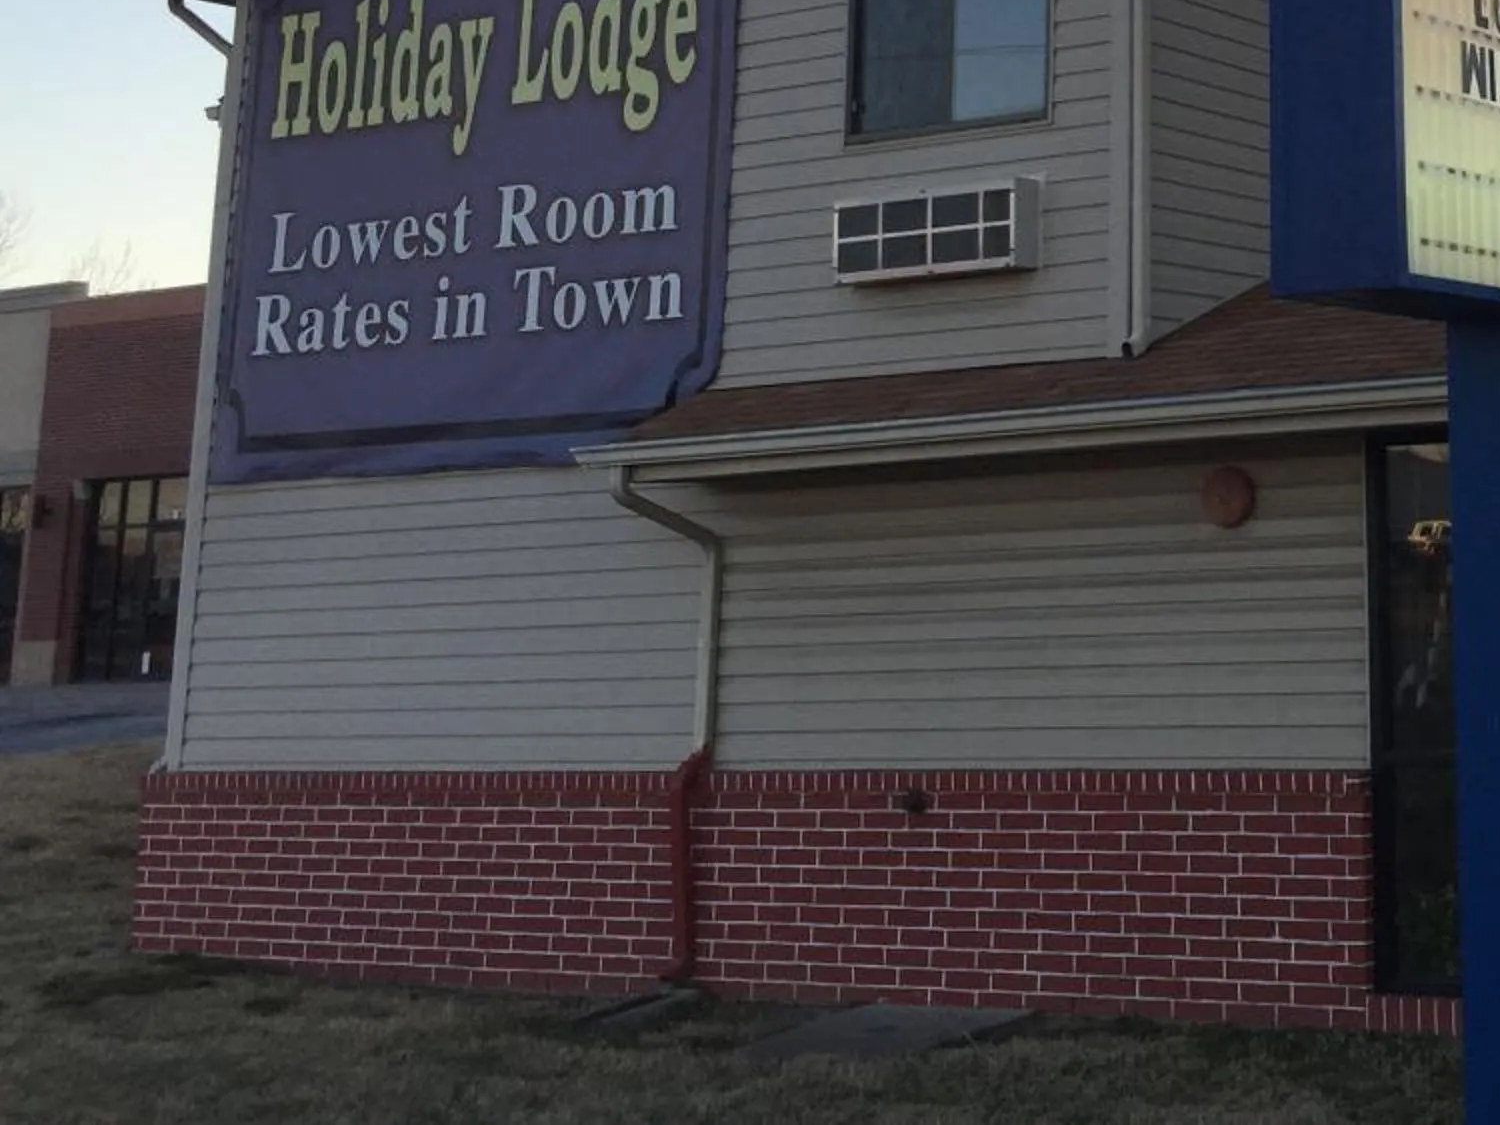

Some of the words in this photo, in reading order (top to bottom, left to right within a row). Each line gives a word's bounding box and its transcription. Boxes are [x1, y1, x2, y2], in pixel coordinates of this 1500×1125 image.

[268, 194, 473, 274] Lowest
[494, 183, 679, 250] Room
[251, 294, 412, 357] Rates
[431, 276, 487, 341] in
[514, 266, 684, 334] Town
